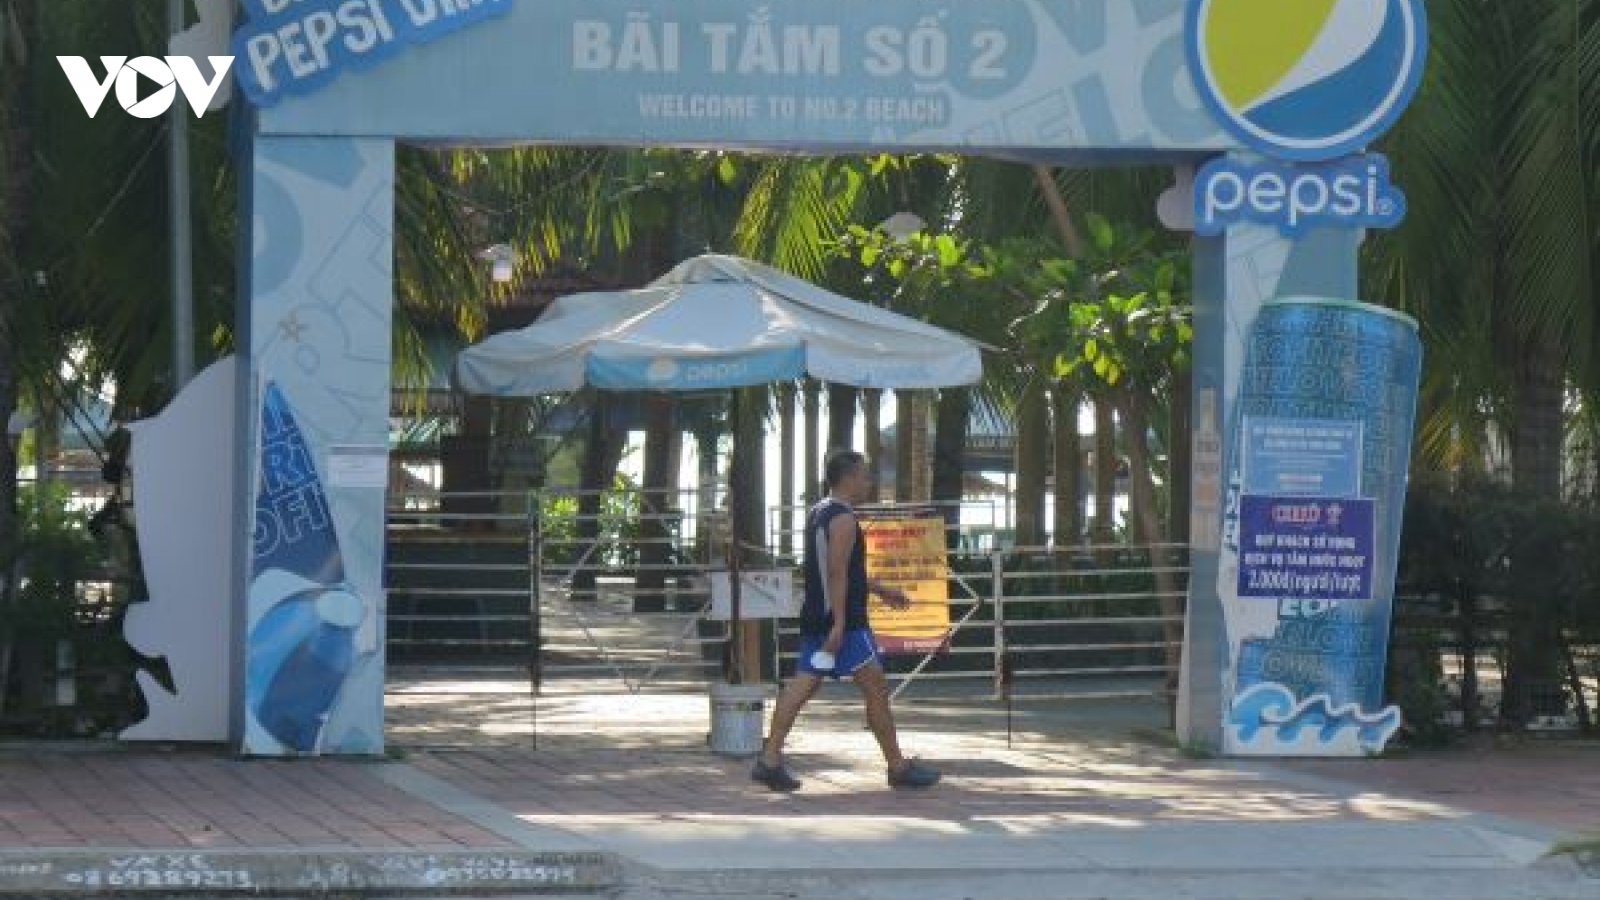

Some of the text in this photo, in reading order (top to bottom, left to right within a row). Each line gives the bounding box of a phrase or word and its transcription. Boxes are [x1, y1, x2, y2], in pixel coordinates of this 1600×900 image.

[247, 0, 393, 92] PEPSI
[572, 13, 681, 71] BÃI
[704, 5, 840, 76] TẮM
[864, 8, 948, 79] SỐ
[969, 31, 1007, 79] 2
[640, 94, 758, 118] WELCOME
[769, 97, 794, 117] TO
[865, 97, 944, 123] BEACH
[1204, 163, 1378, 227] pepsi
